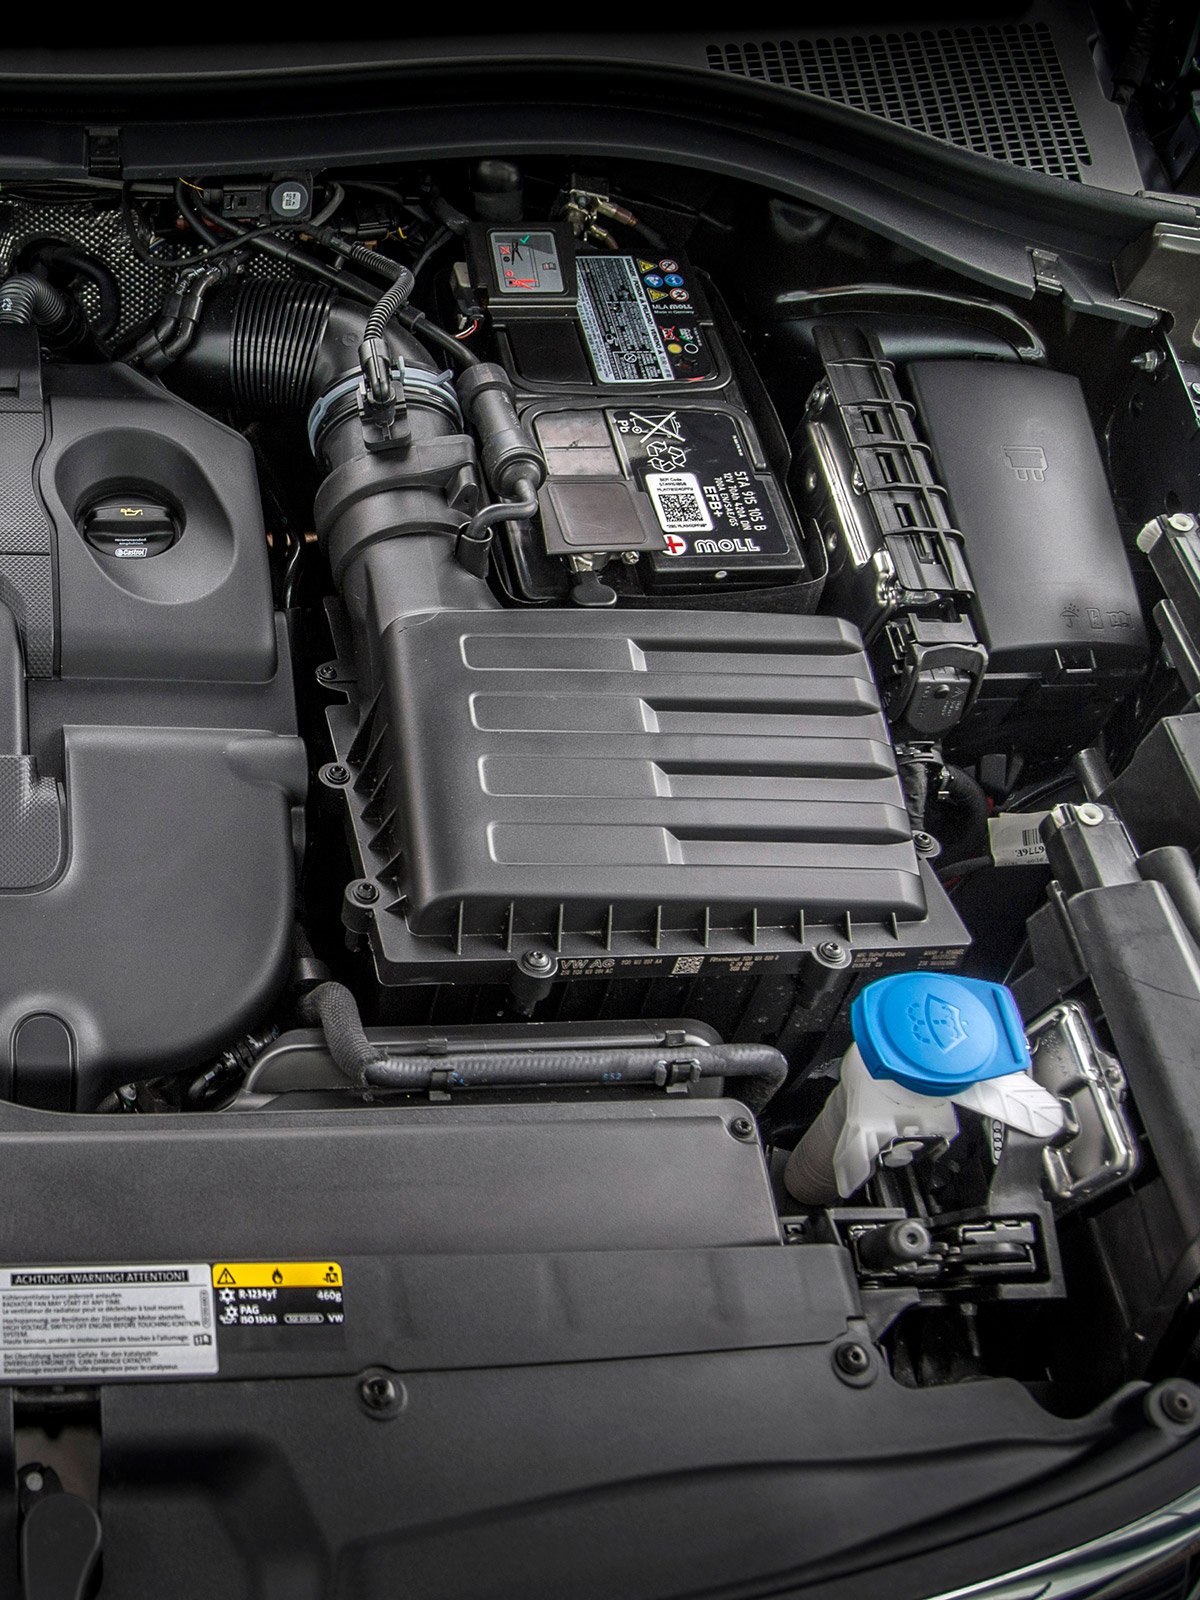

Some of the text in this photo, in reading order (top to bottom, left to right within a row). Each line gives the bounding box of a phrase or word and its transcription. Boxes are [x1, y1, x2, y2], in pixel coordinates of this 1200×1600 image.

[617, 420, 630, 433] Pb
[734, 471, 751, 488] 5TA
[703, 486, 723, 518] EFB+
[723, 472, 752, 531] 12V 70Ah 420A DIN
[742, 491, 757, 505] 915
[720, 493, 739, 527] EN/SAE/GS
[748, 508, 763, 522] 105
[694, 538, 761, 553] MOLL
[560, 960, 589, 969] VW
[589, 958, 616, 968] AG
[15, 1271, 185, 1284] ACHTUNG! WARNING! ATTENTION!
[238, 1288, 342, 1303] R-1234yf 460g
[240, 1304, 260, 1315] PAG
[240, 1315, 254, 1324] ISO
[327, 1313, 344, 1323] VW
